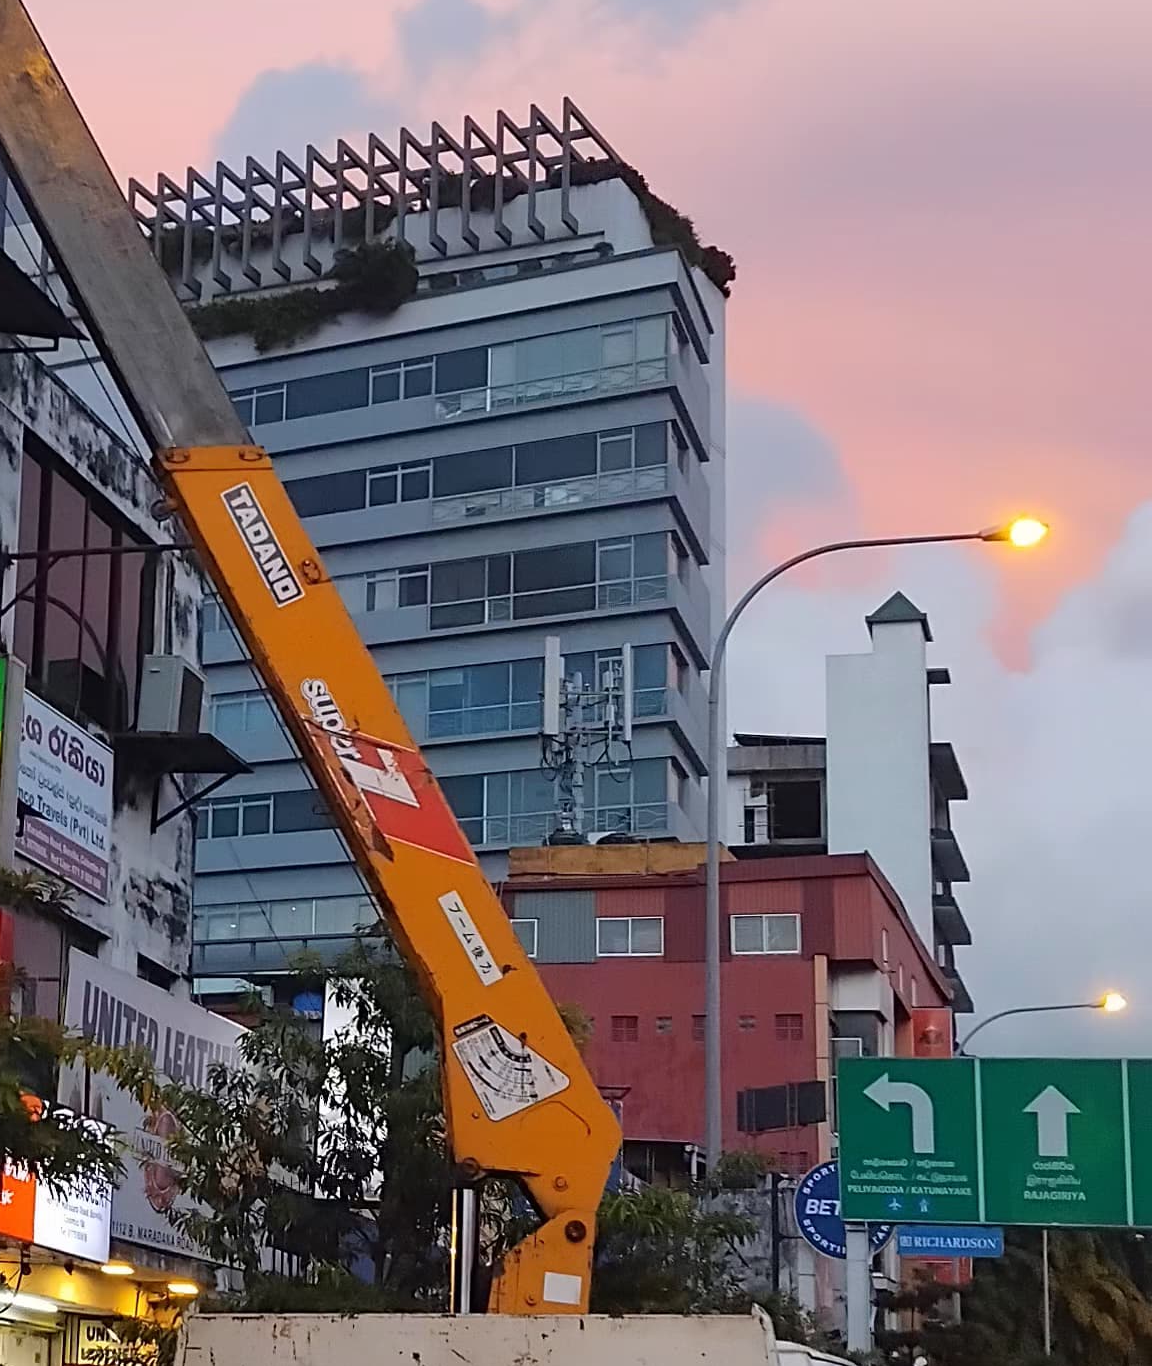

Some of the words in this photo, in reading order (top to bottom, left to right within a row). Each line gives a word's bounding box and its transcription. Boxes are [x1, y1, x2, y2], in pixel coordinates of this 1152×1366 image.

[229, 488, 300, 602] TADANO
[37, 795, 68, 829] Travels
[70, 815, 89, 844] (Pvt)
[83, 980, 159, 1063] UNITED
[848, 1185, 904, 1194] PELIYAGODA
[911, 1186, 972, 1196] KATUNAYAKE
[1024, 1190, 1086, 1202] RAJAGIRIYA
[914, 1235, 998, 1250] RICHARDSON
